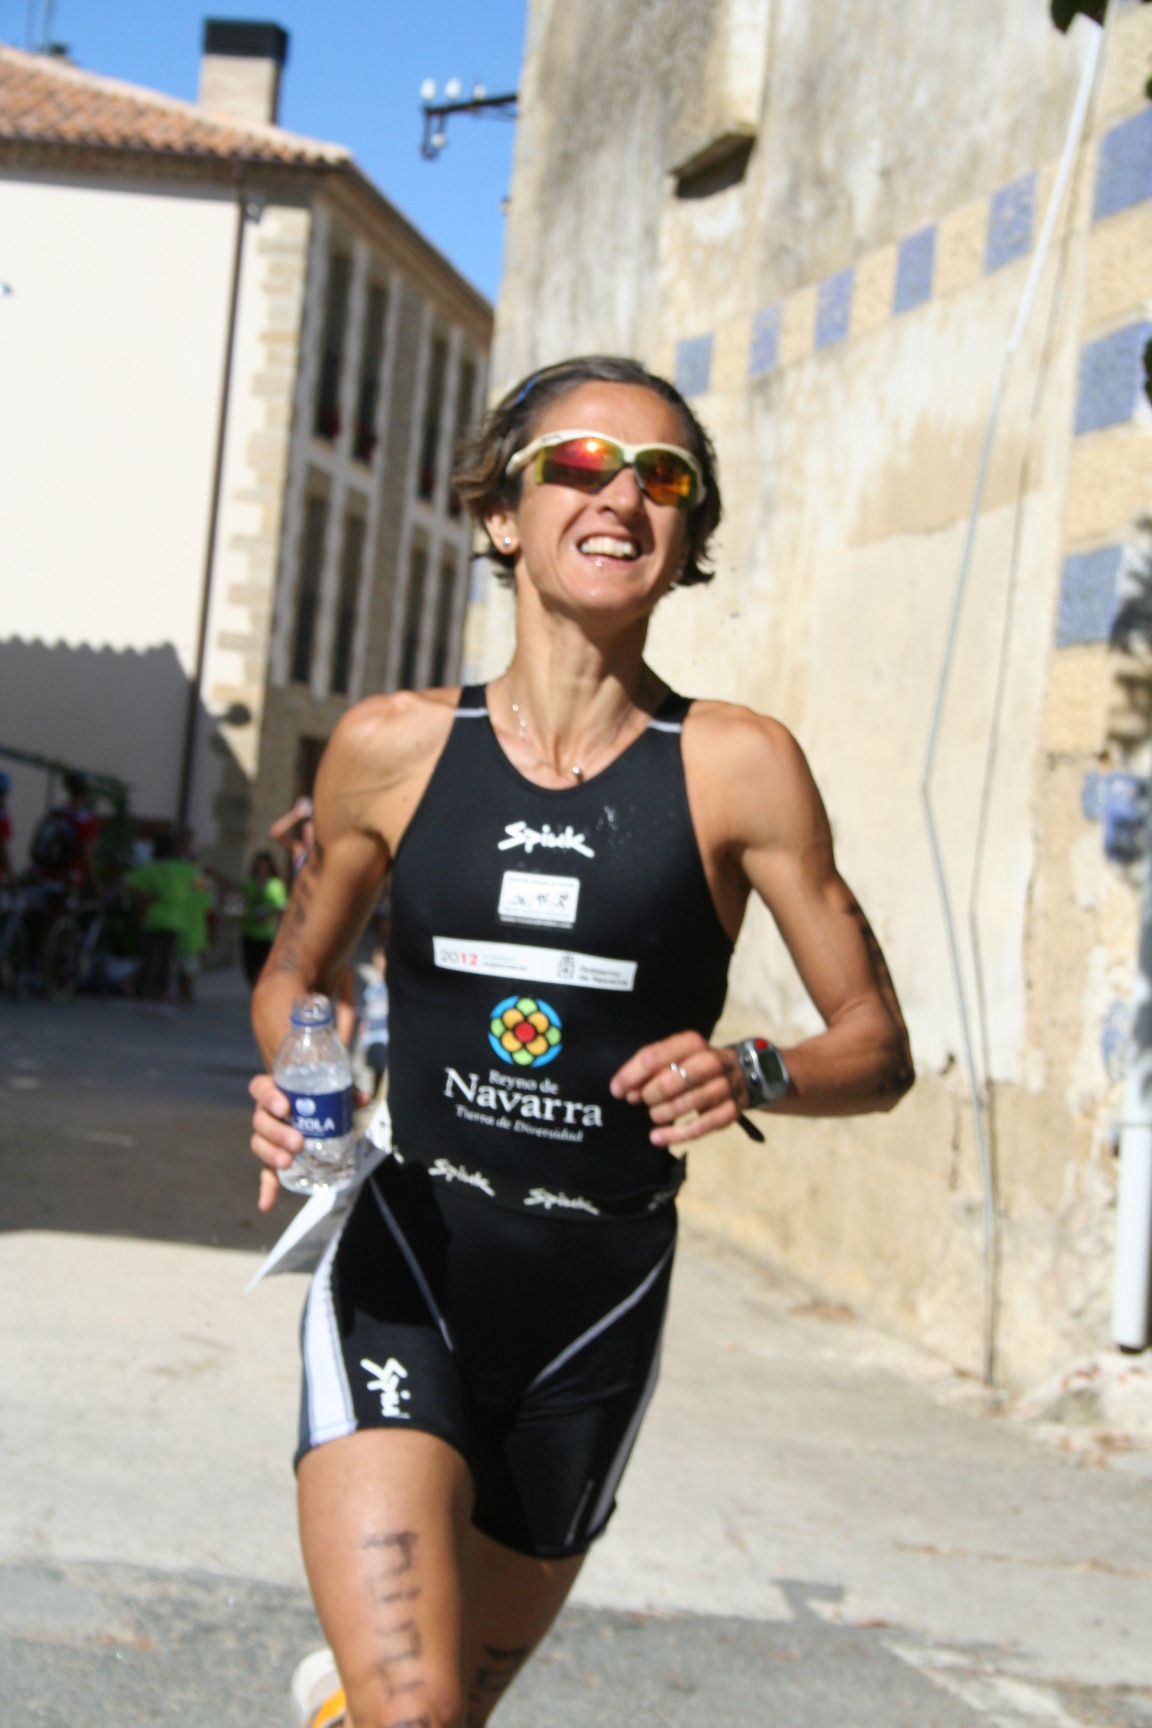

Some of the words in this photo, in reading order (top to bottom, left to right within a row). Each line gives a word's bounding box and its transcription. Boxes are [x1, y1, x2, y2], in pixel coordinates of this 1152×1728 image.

[497, 820, 596, 859] Spiuk
[439, 948, 479, 967] 2012
[443, 1066, 604, 1128] Navarra
[489, 1069, 537, 1091] Reyno
[539, 1077, 559, 1095] de
[455, 1104, 495, 1126] Tierra
[495, 1116, 513, 1130] de
[513, 1119, 584, 1143] Diversidad
